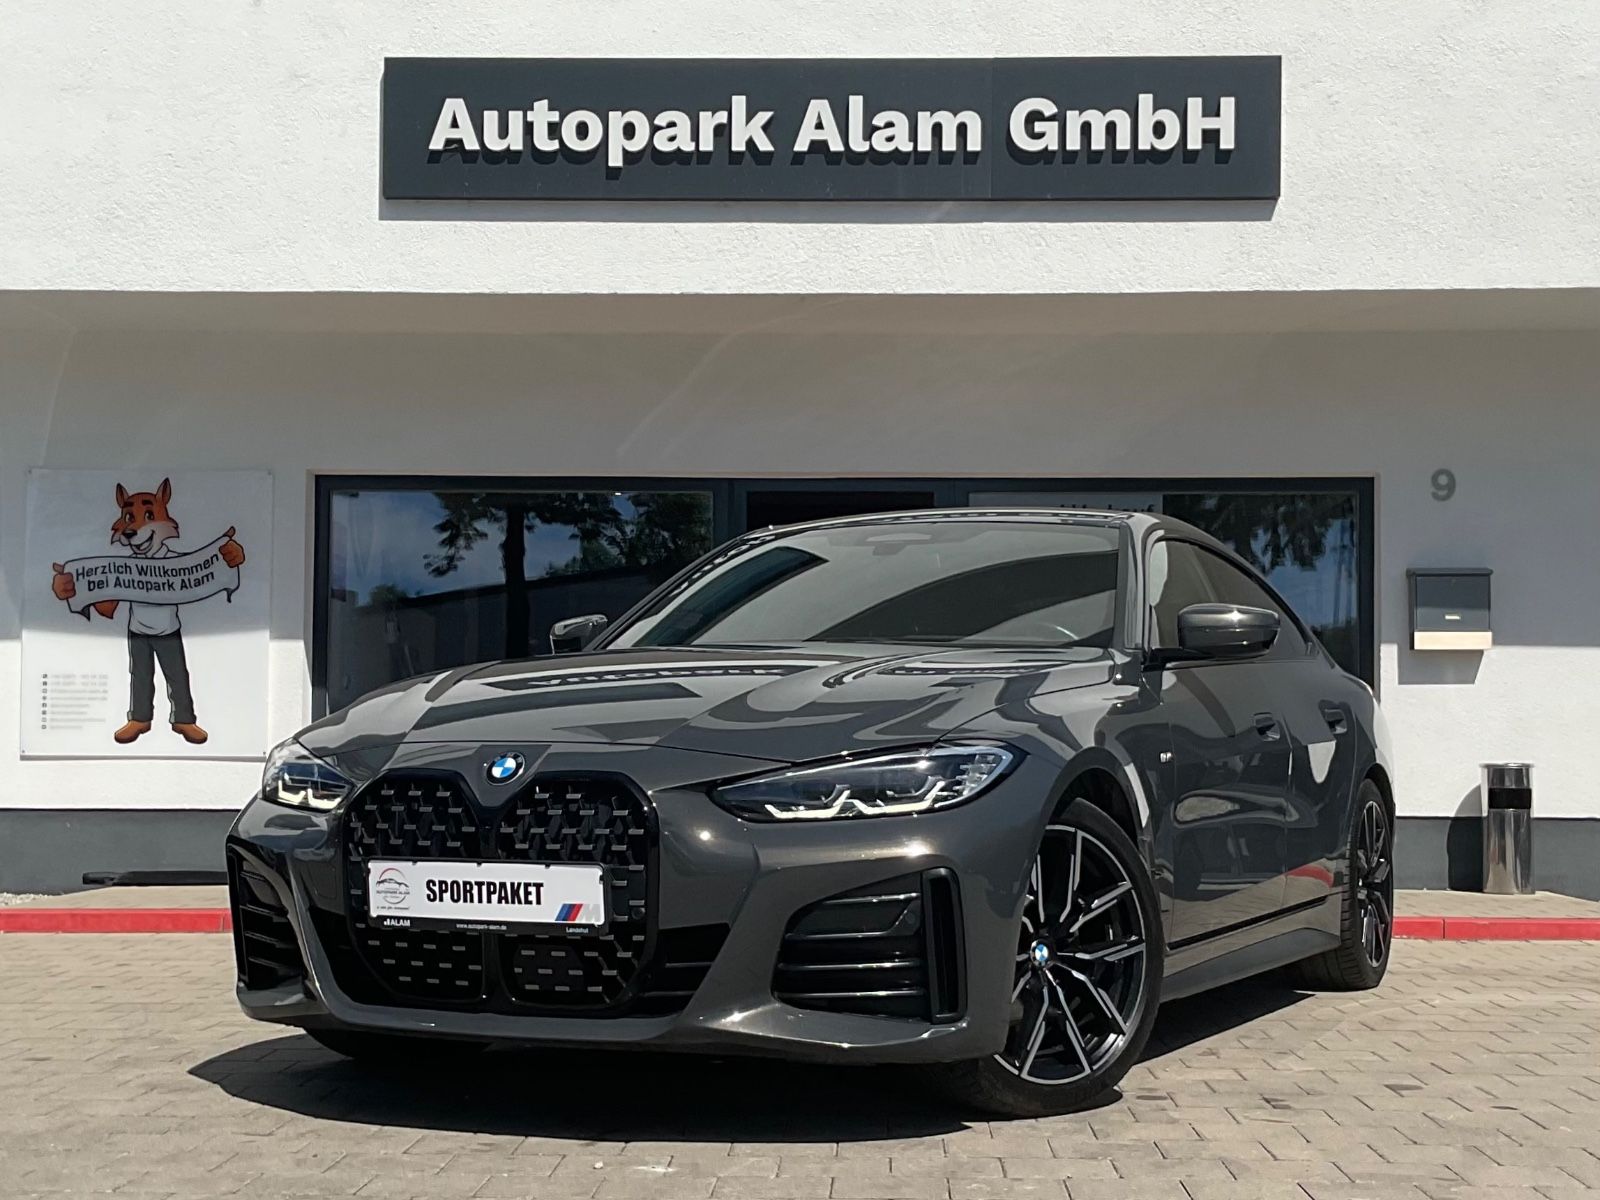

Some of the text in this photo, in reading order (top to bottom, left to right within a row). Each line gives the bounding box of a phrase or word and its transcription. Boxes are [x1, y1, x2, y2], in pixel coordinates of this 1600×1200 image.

[428, 93, 1235, 167] Autopark Alam GmbH
[1431, 468, 1456, 501] 9
[75, 553, 219, 581] Herzlich Willkommen
[88, 572, 215, 592] bei Autopark Alam
[426, 879, 544, 905] SPORTPAKET
